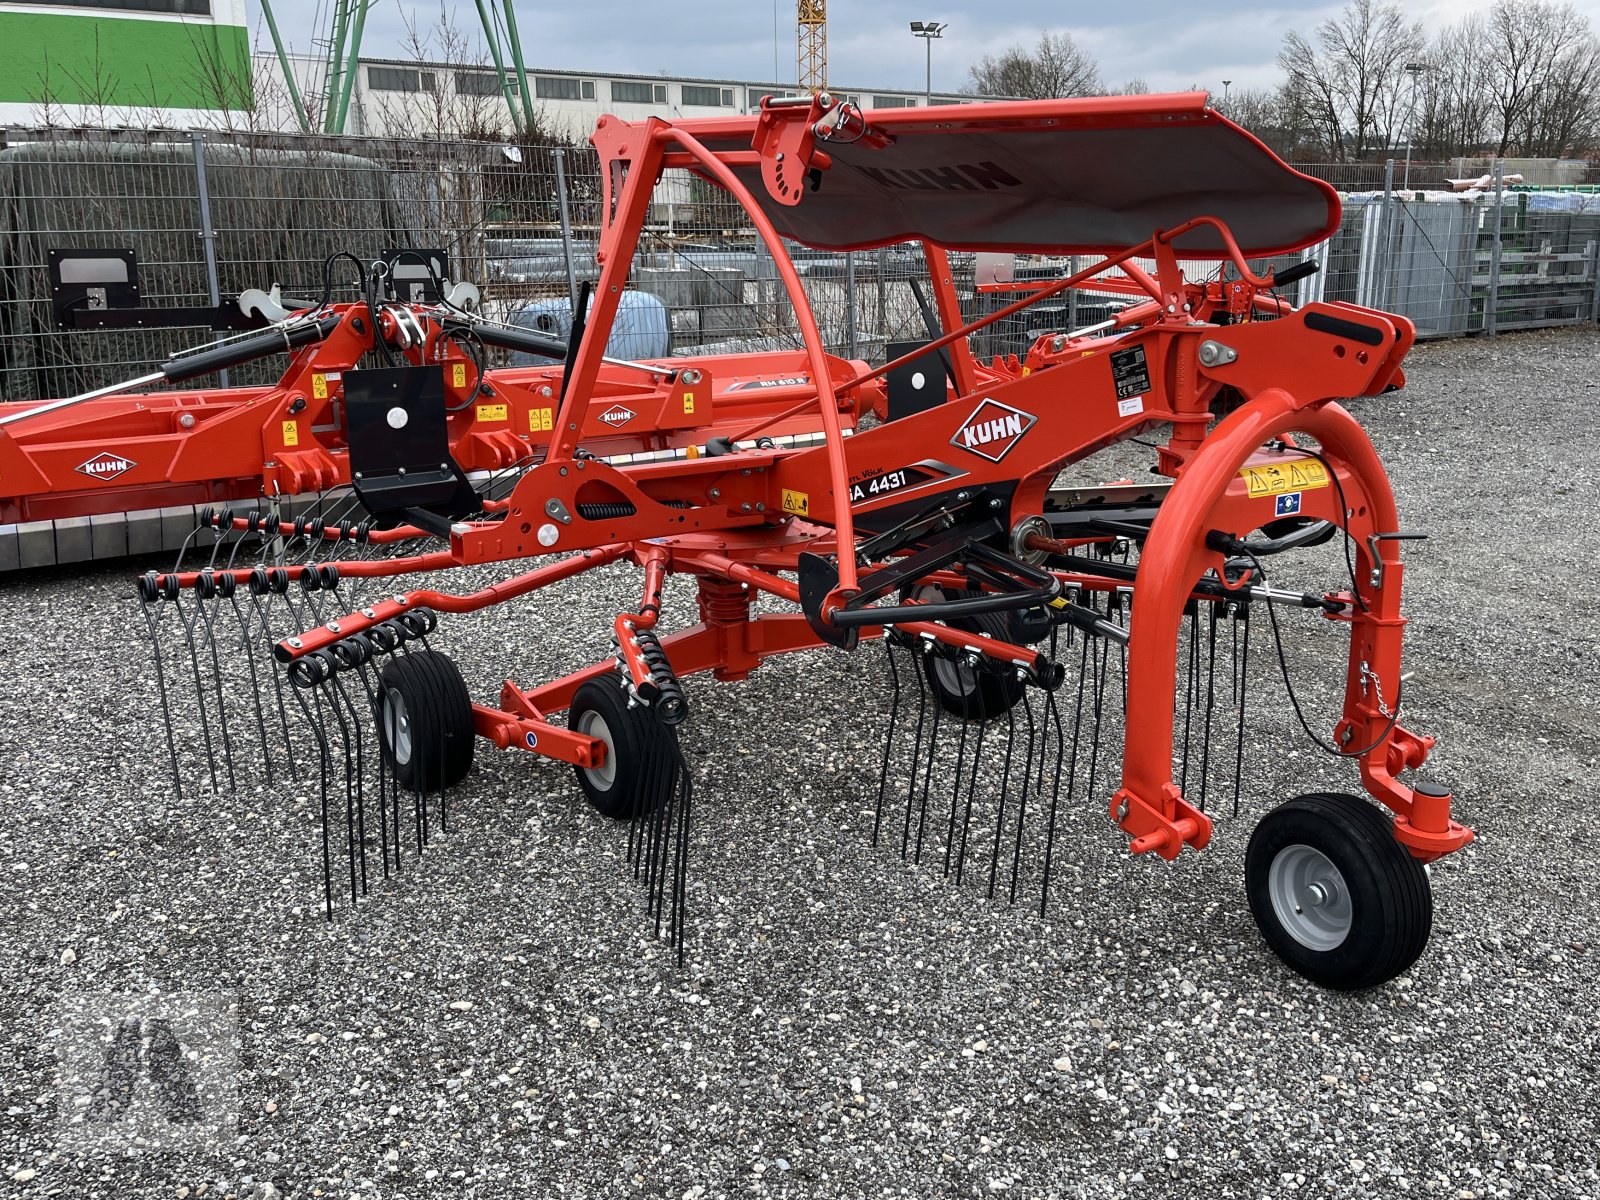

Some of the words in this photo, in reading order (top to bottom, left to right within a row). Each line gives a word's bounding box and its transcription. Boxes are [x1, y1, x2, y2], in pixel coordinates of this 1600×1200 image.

[853, 161, 1023, 190] KUHN
[604, 410, 631, 422] KUHN
[963, 413, 1022, 448] KUHN
[85, 460, 127, 473] KUHN
[869, 470, 907, 494] 4431
